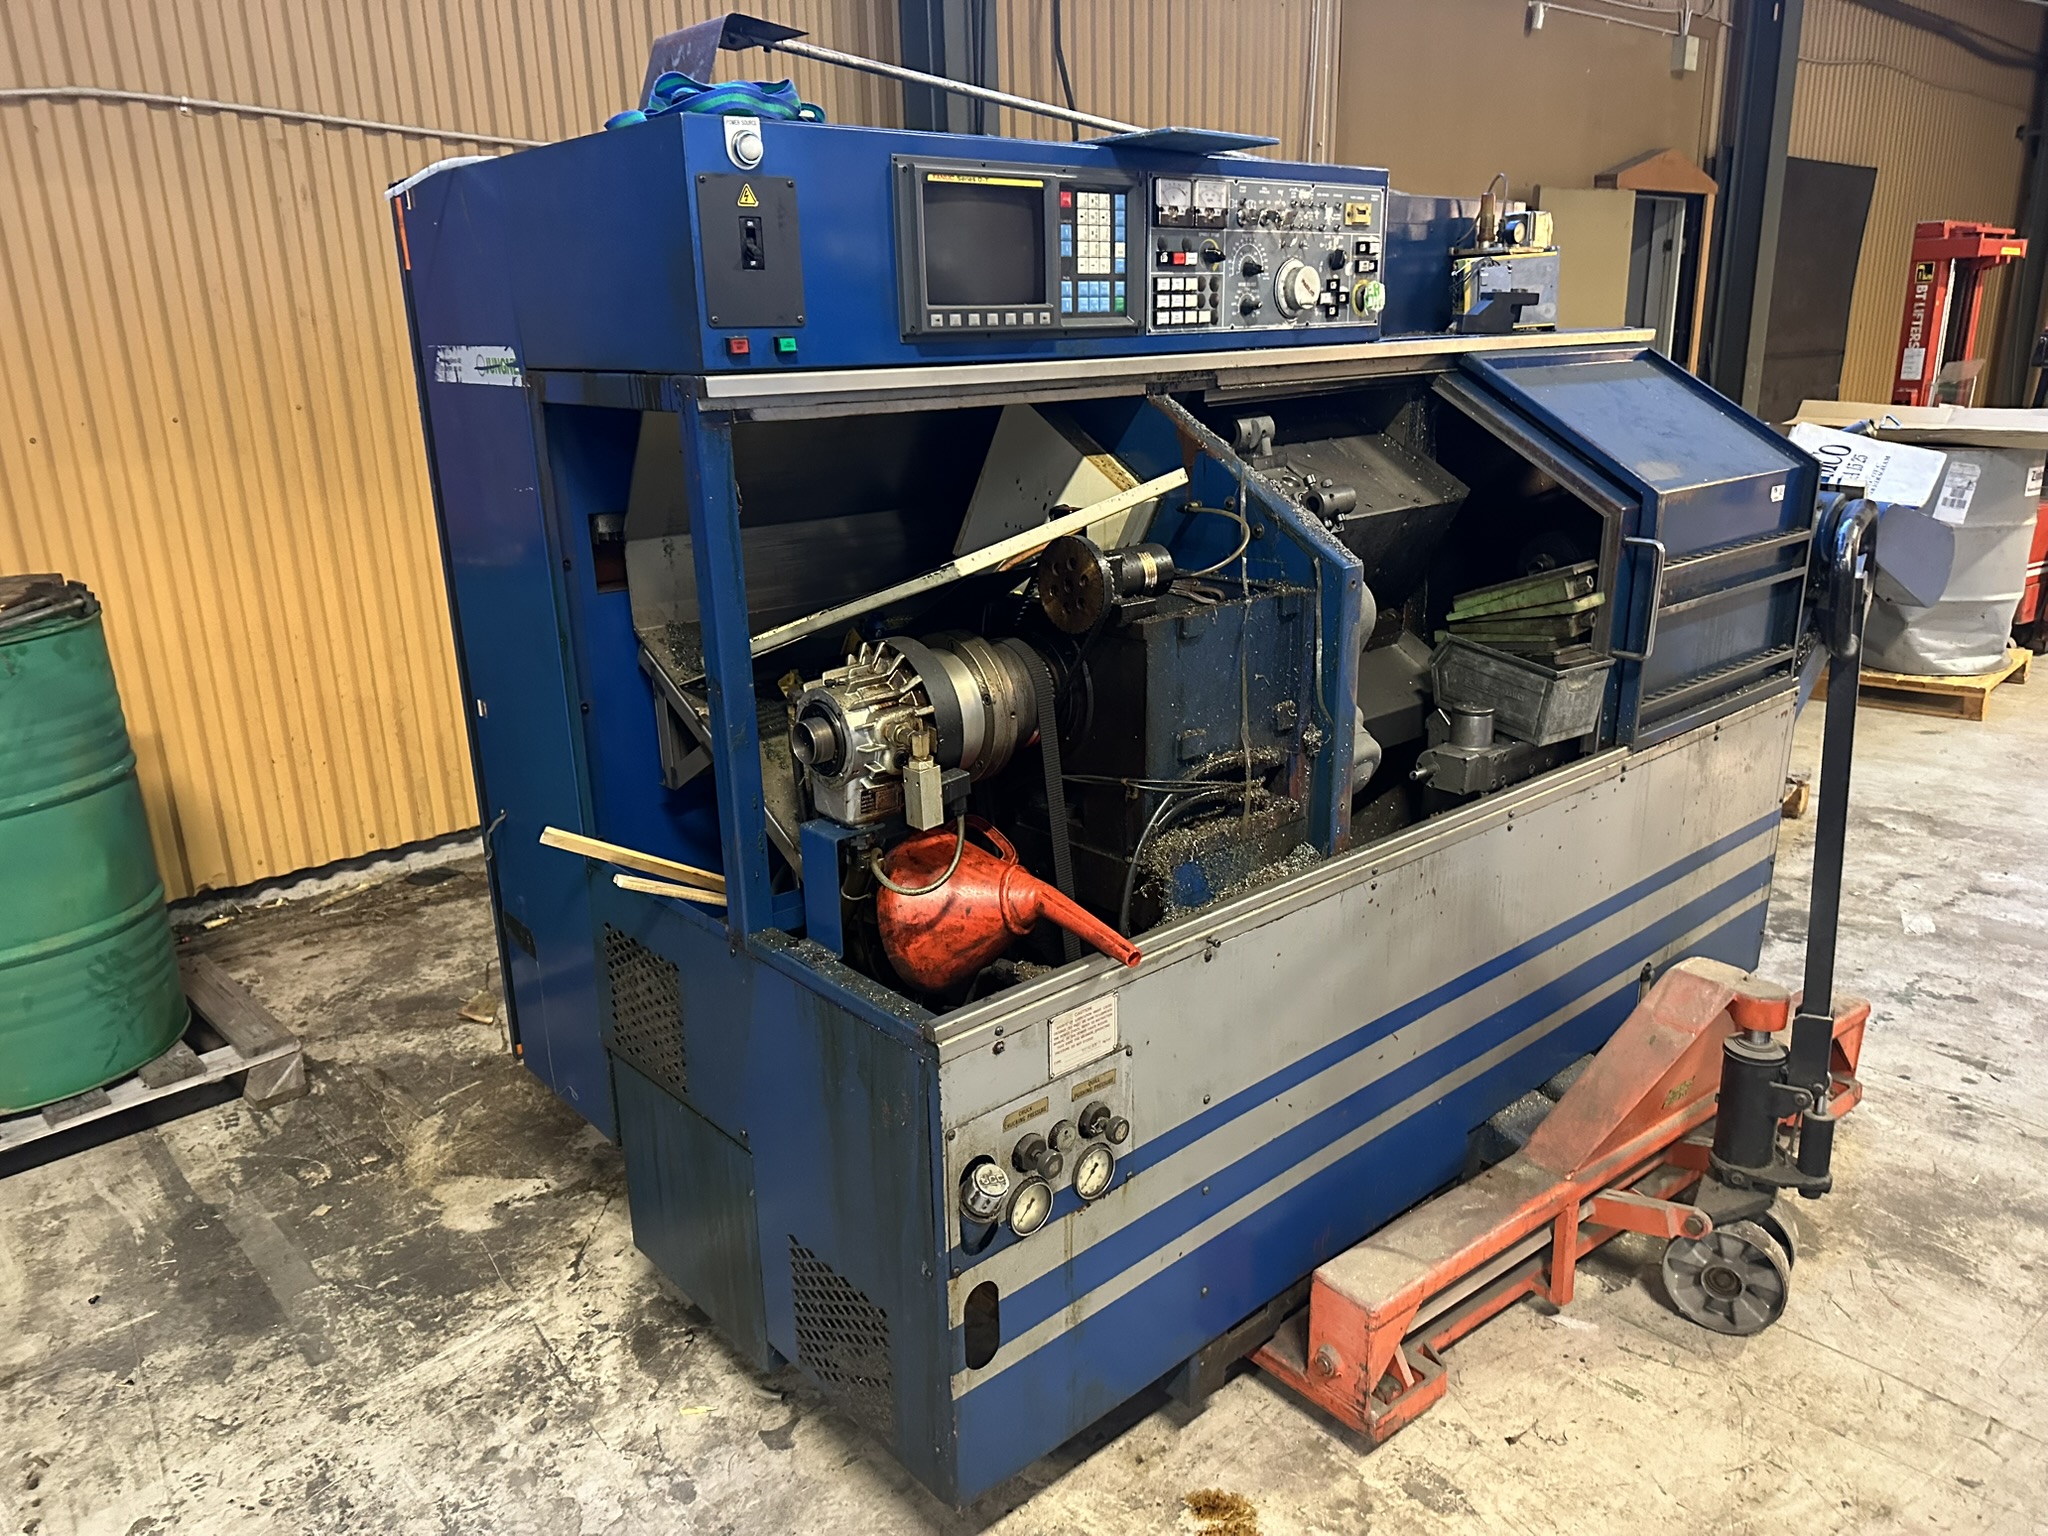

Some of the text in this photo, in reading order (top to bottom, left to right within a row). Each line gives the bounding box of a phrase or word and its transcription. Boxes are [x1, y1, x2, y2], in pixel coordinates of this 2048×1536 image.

[1915, 284, 1928, 300] BT
[1908, 302, 1925, 349] LIFTERS
[1018, 1106, 1033, 1117] CHUCK
[1027, 1106, 1047, 1119] PRESSURE
